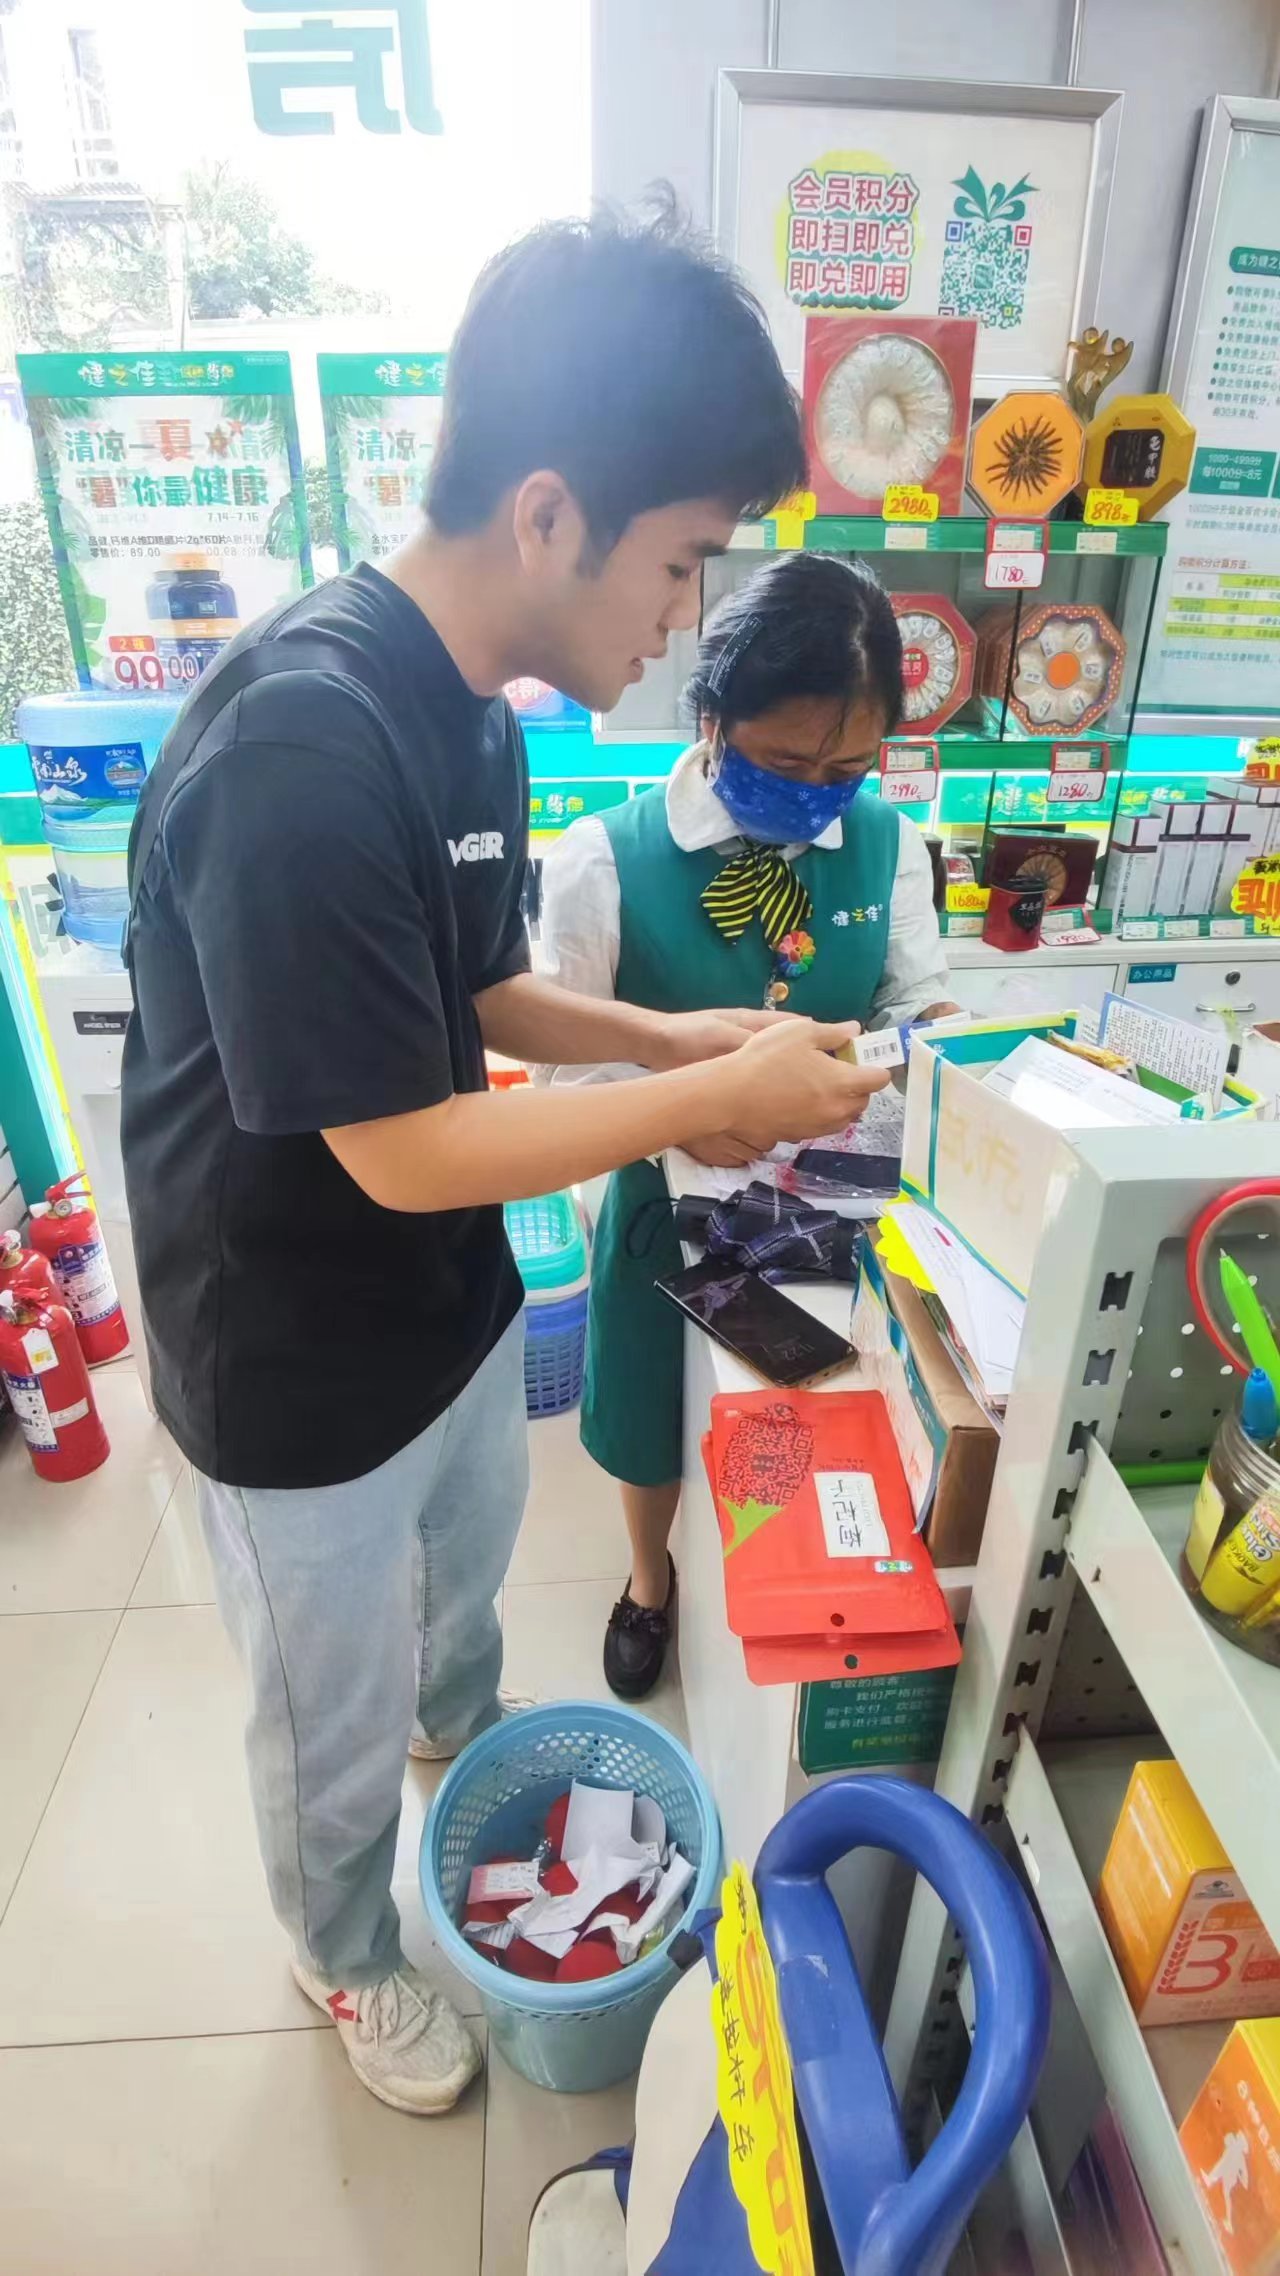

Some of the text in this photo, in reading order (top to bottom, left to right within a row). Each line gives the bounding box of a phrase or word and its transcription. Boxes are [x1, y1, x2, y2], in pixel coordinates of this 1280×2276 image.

[793, 175, 914, 213] 会员积分
[791, 219, 910, 256] 即扫即兑
[790, 261, 907, 297] 即兑即用
[114, 655, 165, 689] 99
[832, 904, 881, 927] 健之佳
